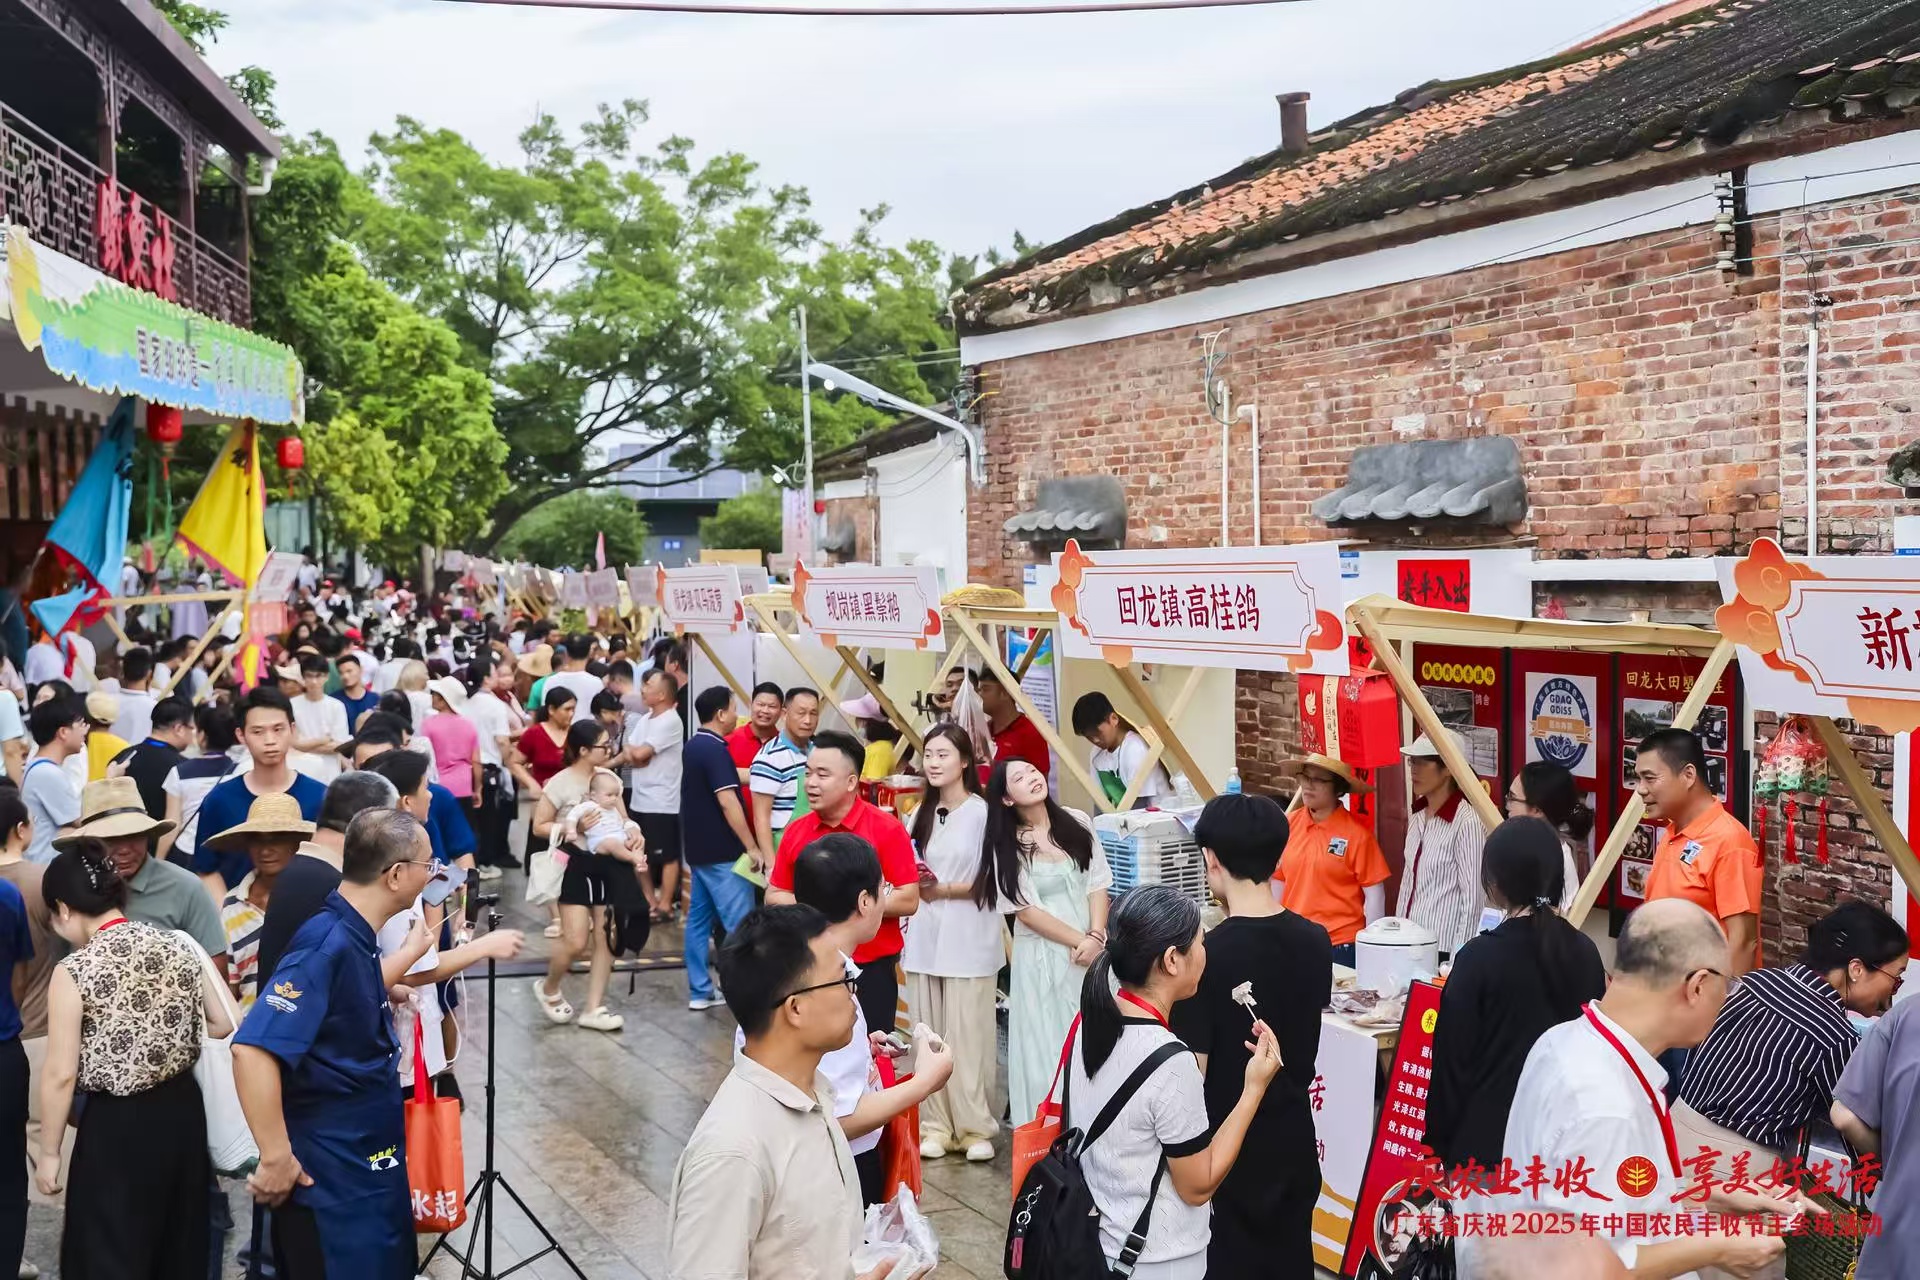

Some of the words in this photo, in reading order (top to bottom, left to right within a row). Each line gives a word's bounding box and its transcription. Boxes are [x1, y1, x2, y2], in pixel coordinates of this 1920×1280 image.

[1116, 584, 1260, 632] 回龙镇·高桂鸽
[1856, 606, 1920, 672] 新
[1549, 694, 1572, 705] GDAQ
[1549, 705, 1572, 716] GDISS
